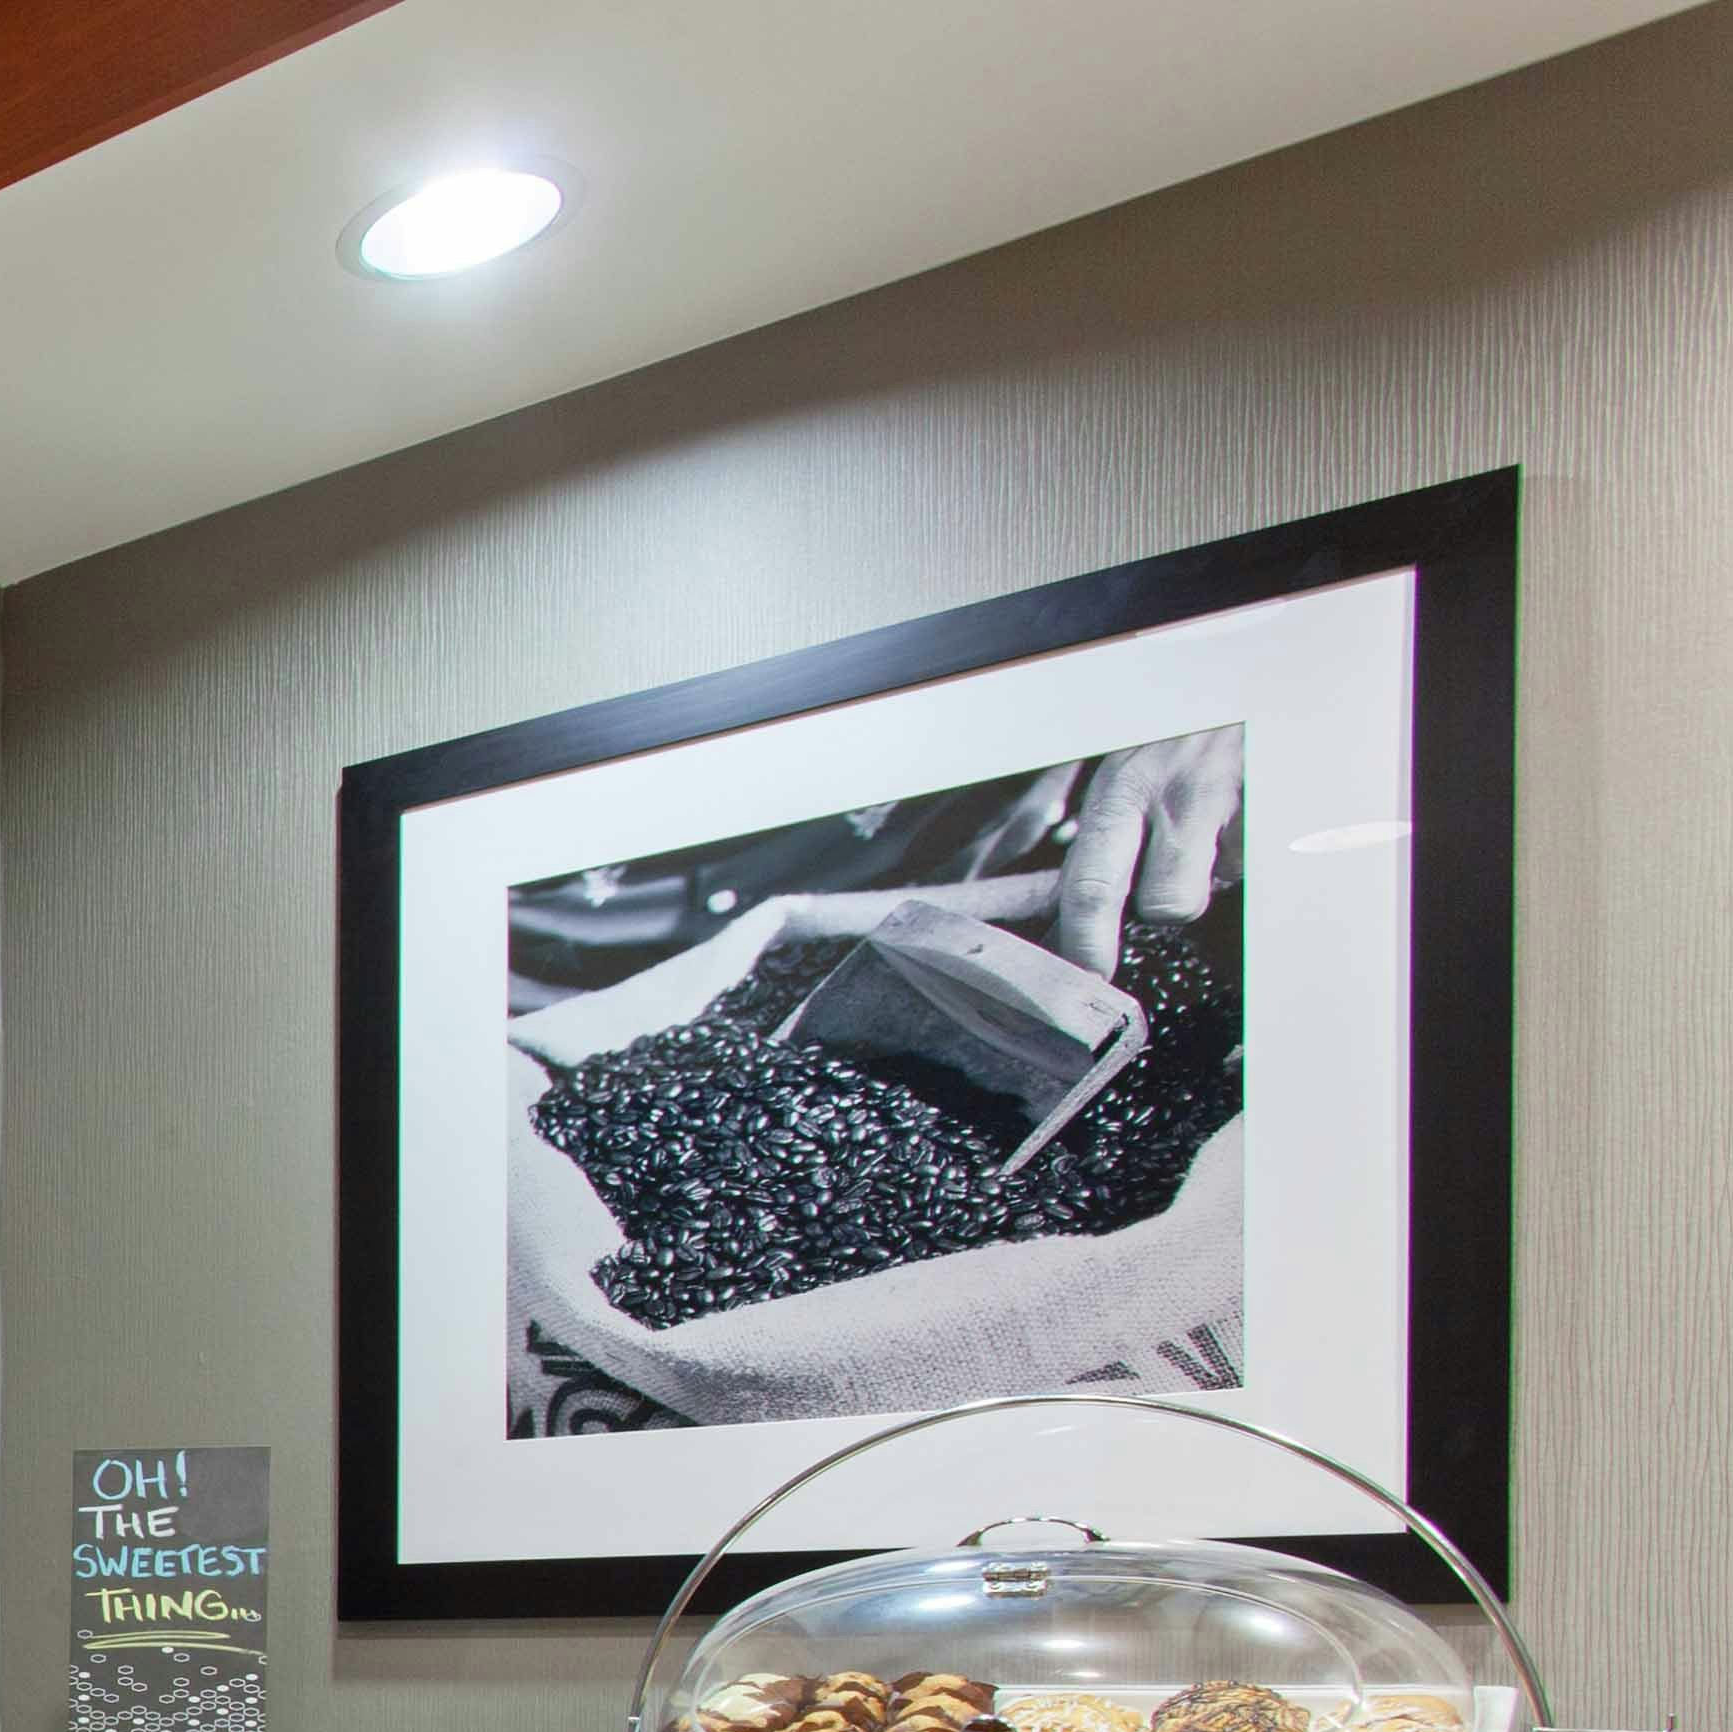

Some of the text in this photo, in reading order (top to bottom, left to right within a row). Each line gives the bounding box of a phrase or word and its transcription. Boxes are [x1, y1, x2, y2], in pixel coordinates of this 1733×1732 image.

[92, 1451, 188, 1501] OH!
[78, 1504, 179, 1539] THE
[73, 1544, 267, 1578] SWEETEST
